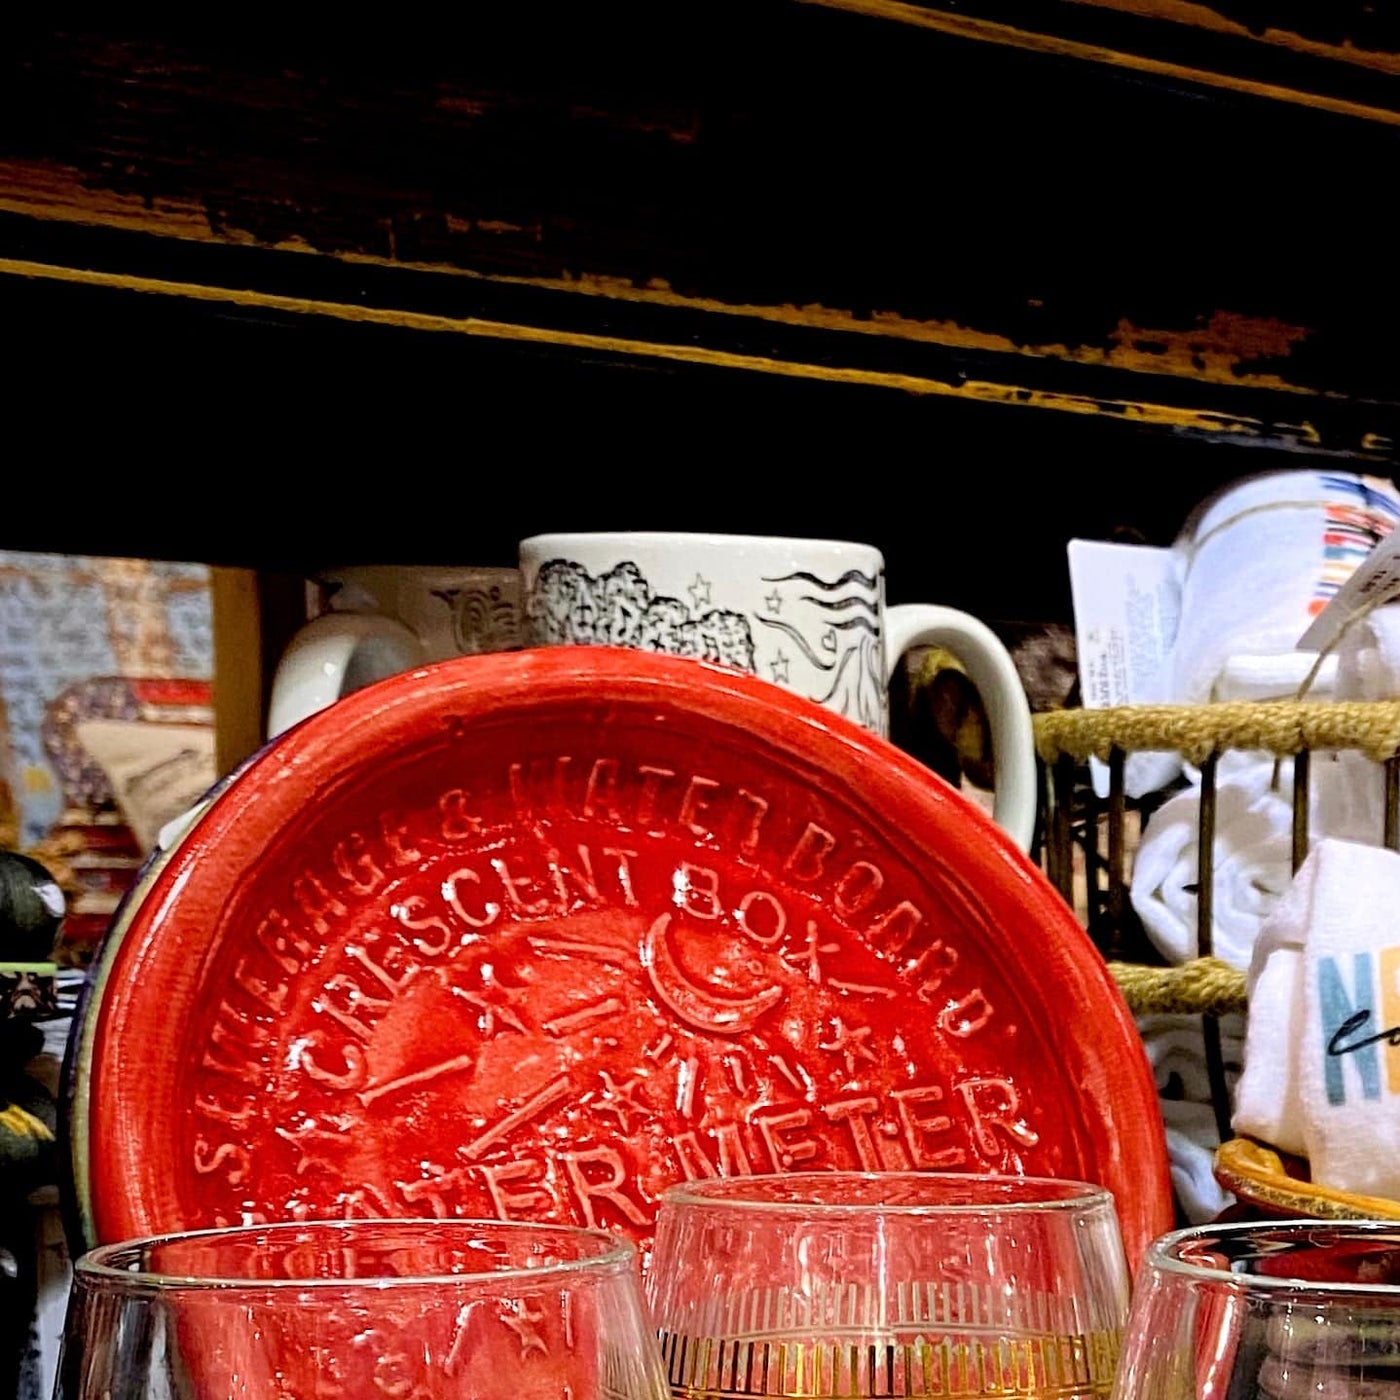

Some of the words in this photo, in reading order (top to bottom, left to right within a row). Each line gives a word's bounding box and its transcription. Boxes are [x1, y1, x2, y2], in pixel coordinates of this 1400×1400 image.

[288, 842, 640, 1092] CRESCENT
[672, 860, 841, 985] BOX
[671, 1078, 1041, 1182] METER
